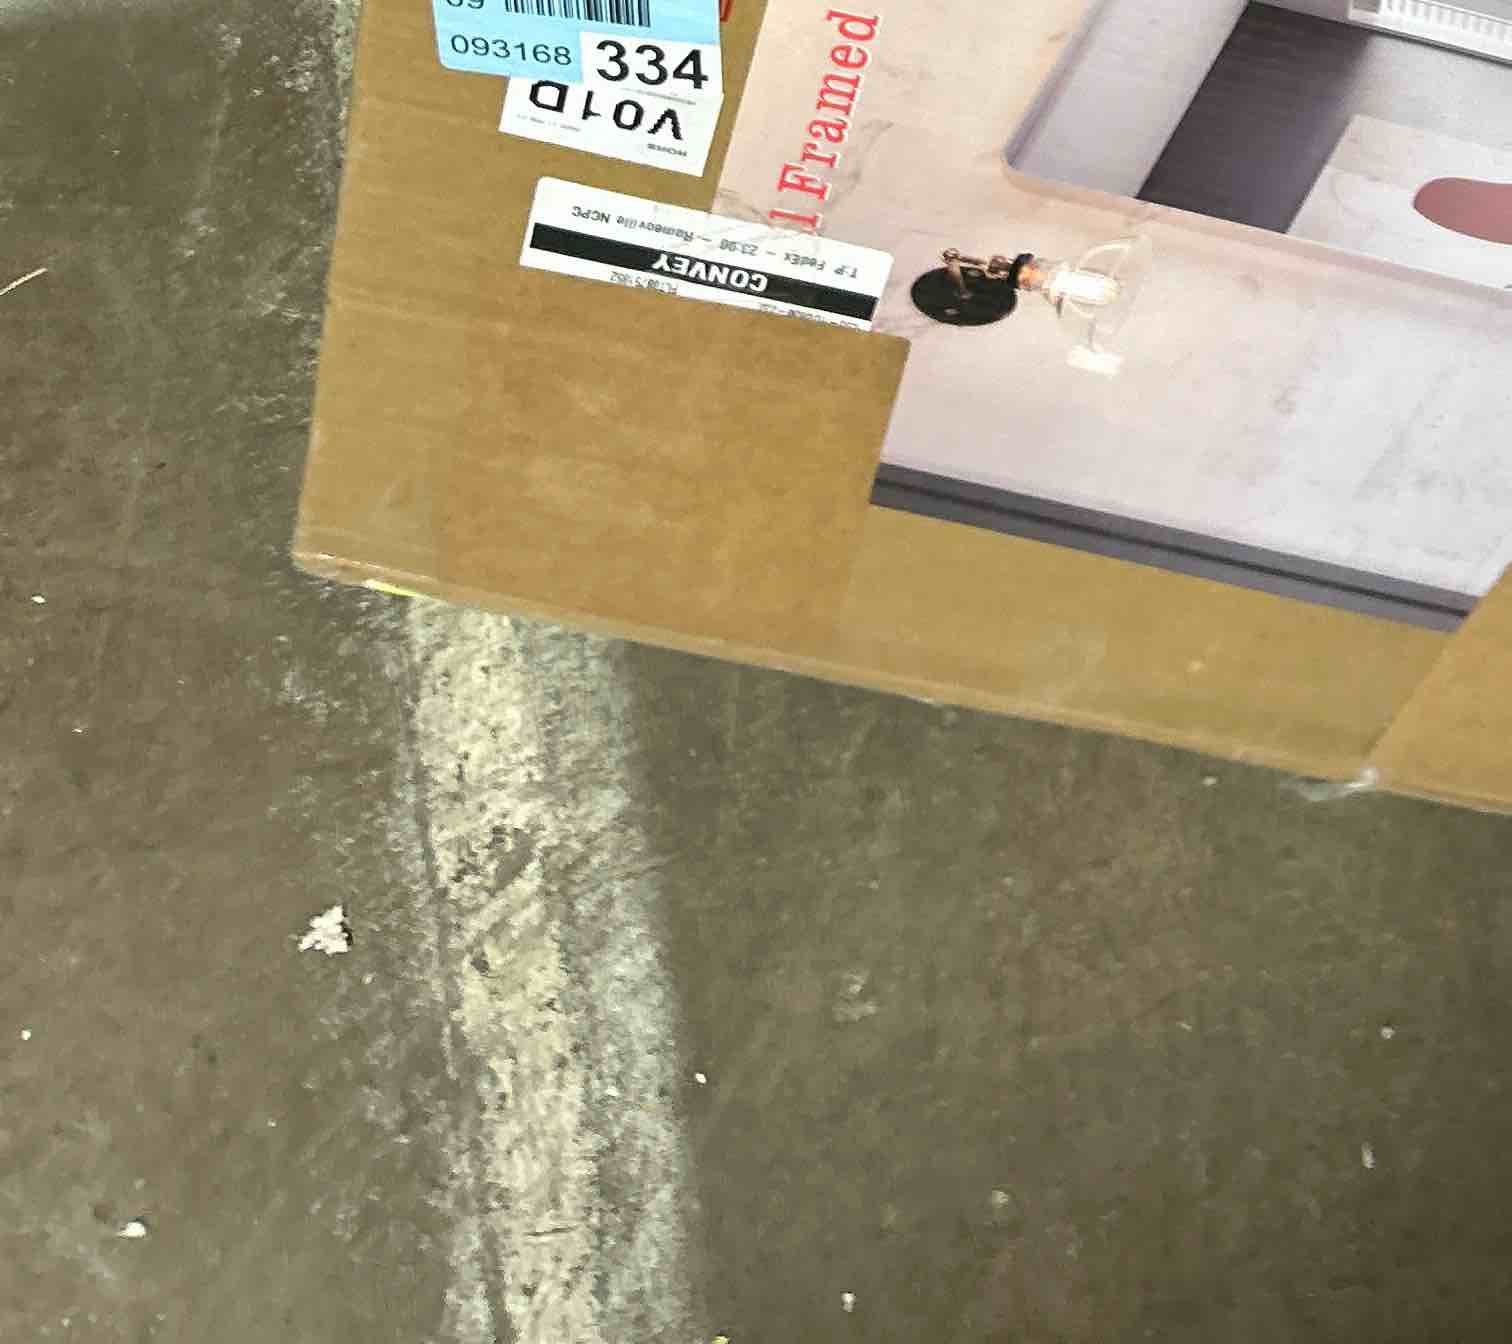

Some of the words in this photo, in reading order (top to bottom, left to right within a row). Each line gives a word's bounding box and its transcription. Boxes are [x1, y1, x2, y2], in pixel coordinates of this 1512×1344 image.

[449, 33, 574, 67] 093168
[596, 38, 709, 91] 334
[777, 9, 880, 201] Framed
[651, 252, 769, 293] CONVEY
